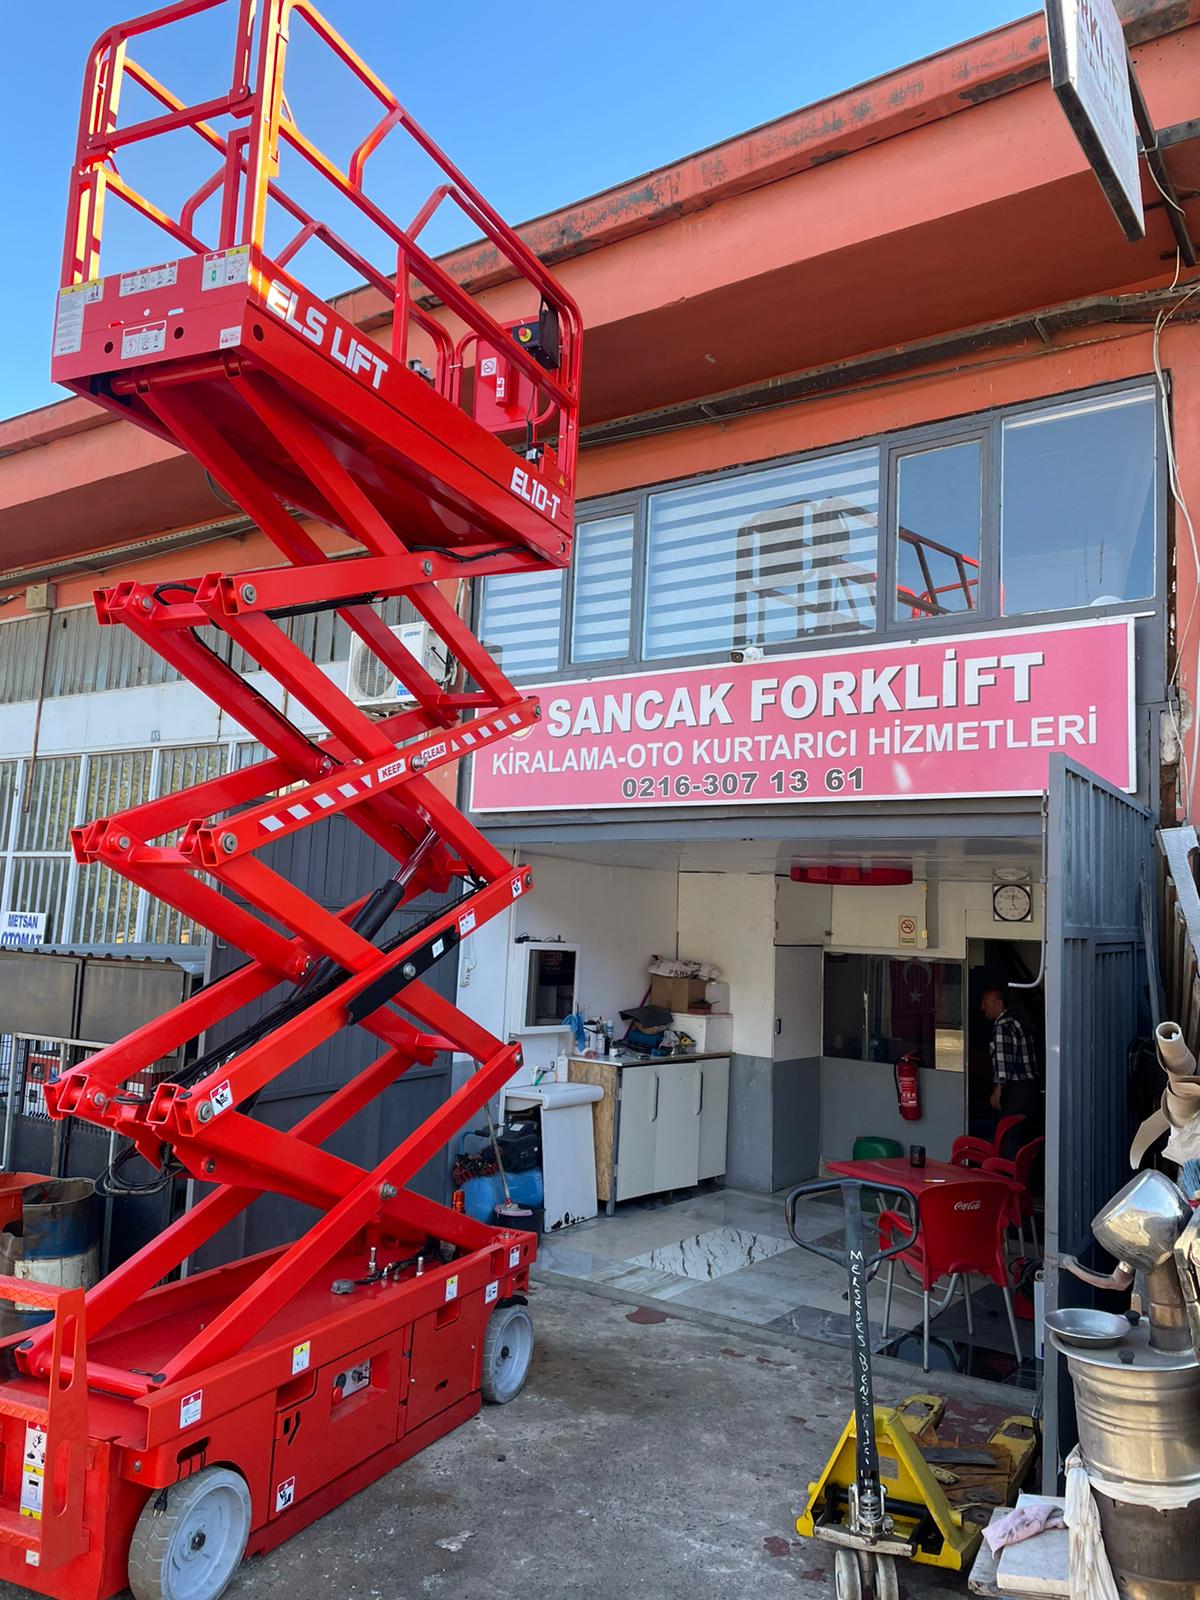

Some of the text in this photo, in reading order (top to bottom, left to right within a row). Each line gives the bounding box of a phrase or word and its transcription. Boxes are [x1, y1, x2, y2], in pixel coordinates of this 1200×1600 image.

[266, 278, 389, 390] ELS LIFT
[495, 376, 505, 397] ELS
[510, 466, 561, 520] EL10-T
[546, 648, 1045, 738] SANCAK FORKLİFT
[381, 744, 446, 778] KEEP CLEAR
[491, 705, 1098, 775] KİRALAMA-OTO KURTARICI HİZMETLERİ
[621, 766, 864, 798] 0216-307 13 61
[8, 914, 39, 928] METSAN
